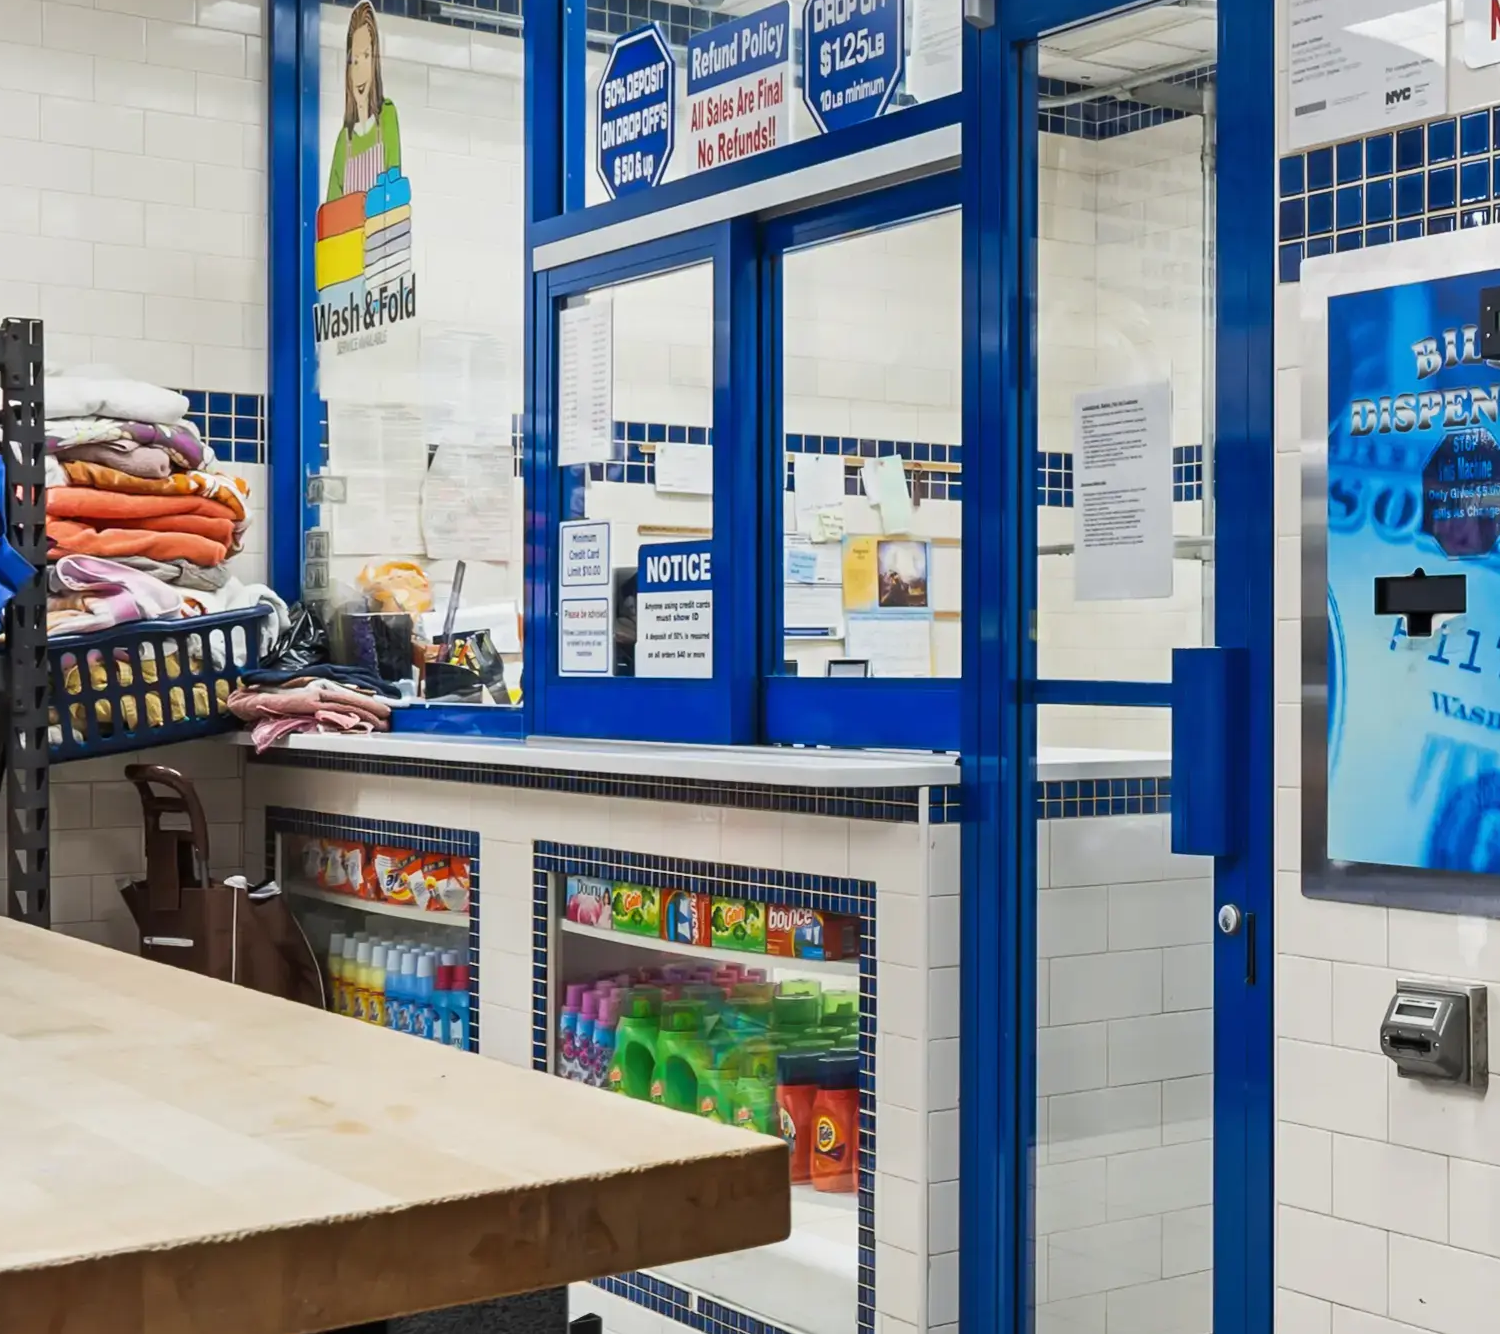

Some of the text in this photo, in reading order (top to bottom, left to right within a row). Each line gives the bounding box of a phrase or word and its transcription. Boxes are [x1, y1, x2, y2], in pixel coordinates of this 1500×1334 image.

[692, 21, 785, 82] Refund Policy
[604, 61, 666, 109] 50% DEPOSIT
[691, 72, 784, 134] All Sales Are Final
[844, 76, 885, 104] minimum
[1385, 87, 1411, 105] NYC
[601, 121, 616, 151] ON
[616, 111, 641, 146] DROP
[697, 115, 776, 170] No Refunds!!
[643, 154, 654, 183] up
[313, 272, 416, 343] Wash & Fold
[646, 553, 711, 583] NOTICE
[768, 907, 813, 933] bounce
